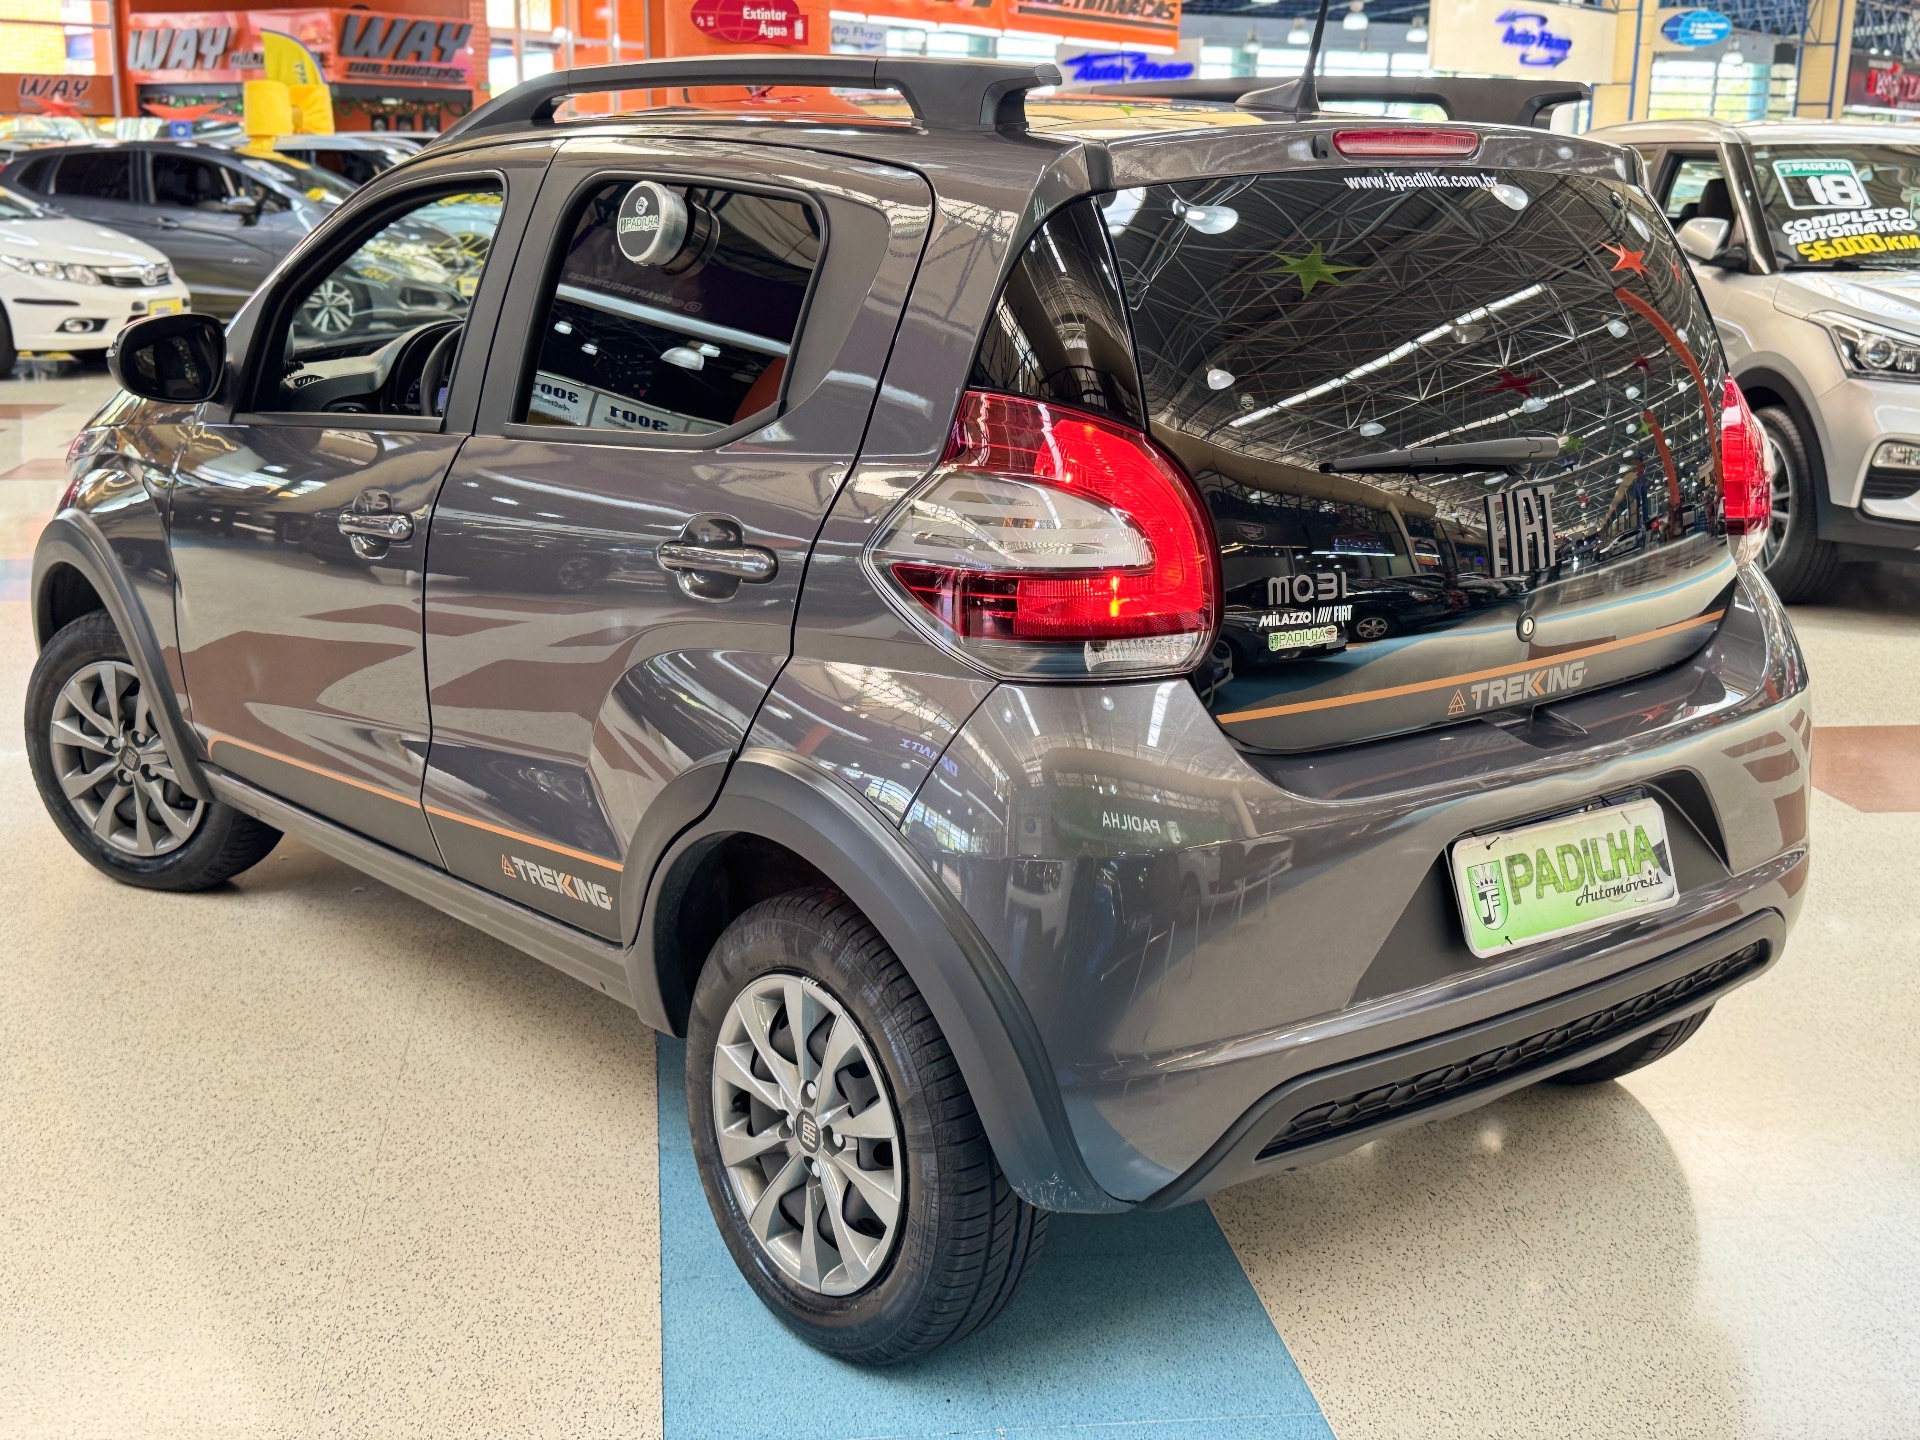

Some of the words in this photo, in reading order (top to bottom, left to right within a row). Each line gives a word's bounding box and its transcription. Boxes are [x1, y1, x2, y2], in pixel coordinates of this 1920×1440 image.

[742, 6, 787, 21] Extintor
[340, 14, 472, 62] WAY
[758, 20, 788, 38] Água
[127, 27, 231, 70] WAY
[19, 77, 90, 98] WAY
[1789, 162, 1850, 172] PADILHA
[1343, 171, 1498, 192] www.jfpadilha.com.br
[1806, 173, 1865, 207] 18
[1781, 206, 1910, 235] COMPLETO
[1486, 484, 1557, 578] FIAT
[1333, 604, 1353, 622] FIAT
[1279, 628, 1327, 645] PADILHA
[1504, 824, 1661, 906] PADILHA
[1575, 870, 1664, 907] Automóveis
